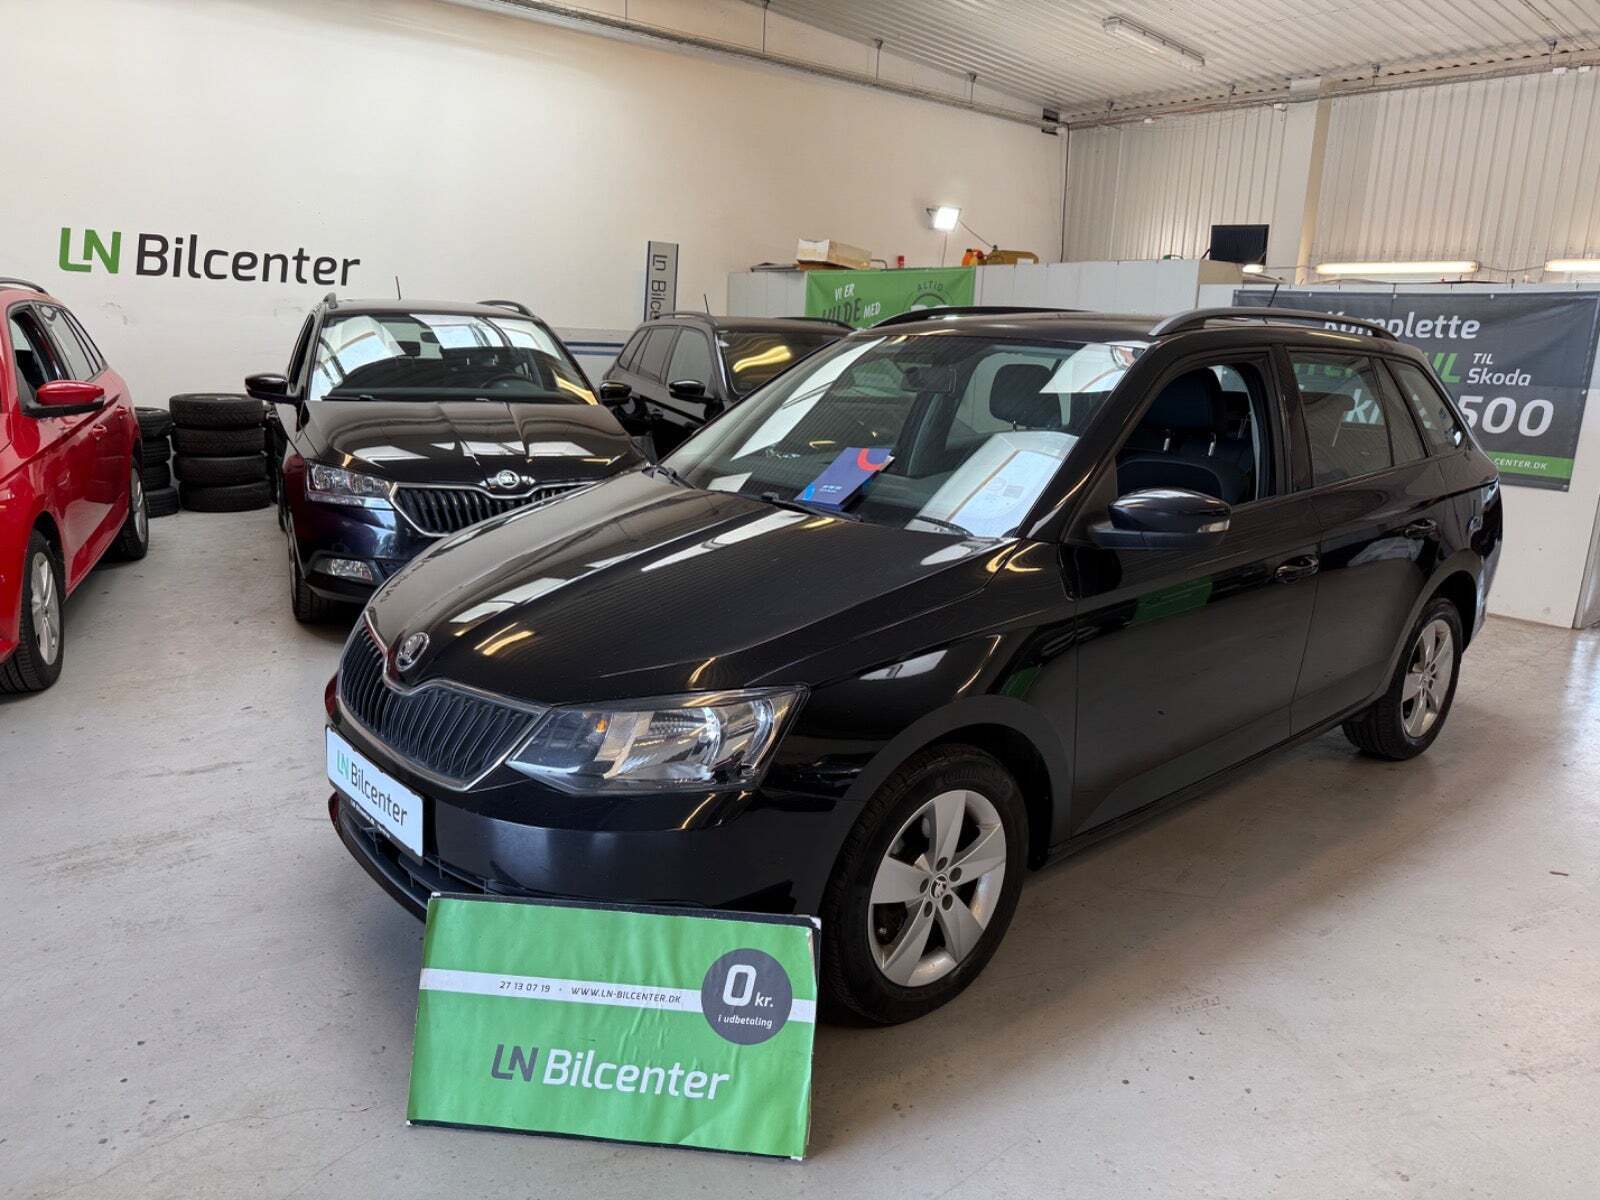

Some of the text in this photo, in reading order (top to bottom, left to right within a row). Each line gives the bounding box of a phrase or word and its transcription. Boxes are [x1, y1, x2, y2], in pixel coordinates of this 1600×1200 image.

[59, 227, 361, 286] LN Bilcenter
[844, 283, 855, 298] ER
[863, 302, 881, 319] MED
[1473, 353, 1493, 365] TIL
[1467, 368, 1531, 386] Skoda
[336, 750, 349, 780] LN
[351, 761, 408, 826] Bilcenter
[500, 981, 681, 1003] 27 13 07 19 WWW.LN-BILCENTER.DK
[722, 964, 774, 1008] 0 kr.
[723, 1015, 773, 1030] udbetaling
[491, 1044, 730, 1100] LN Bilcenter
